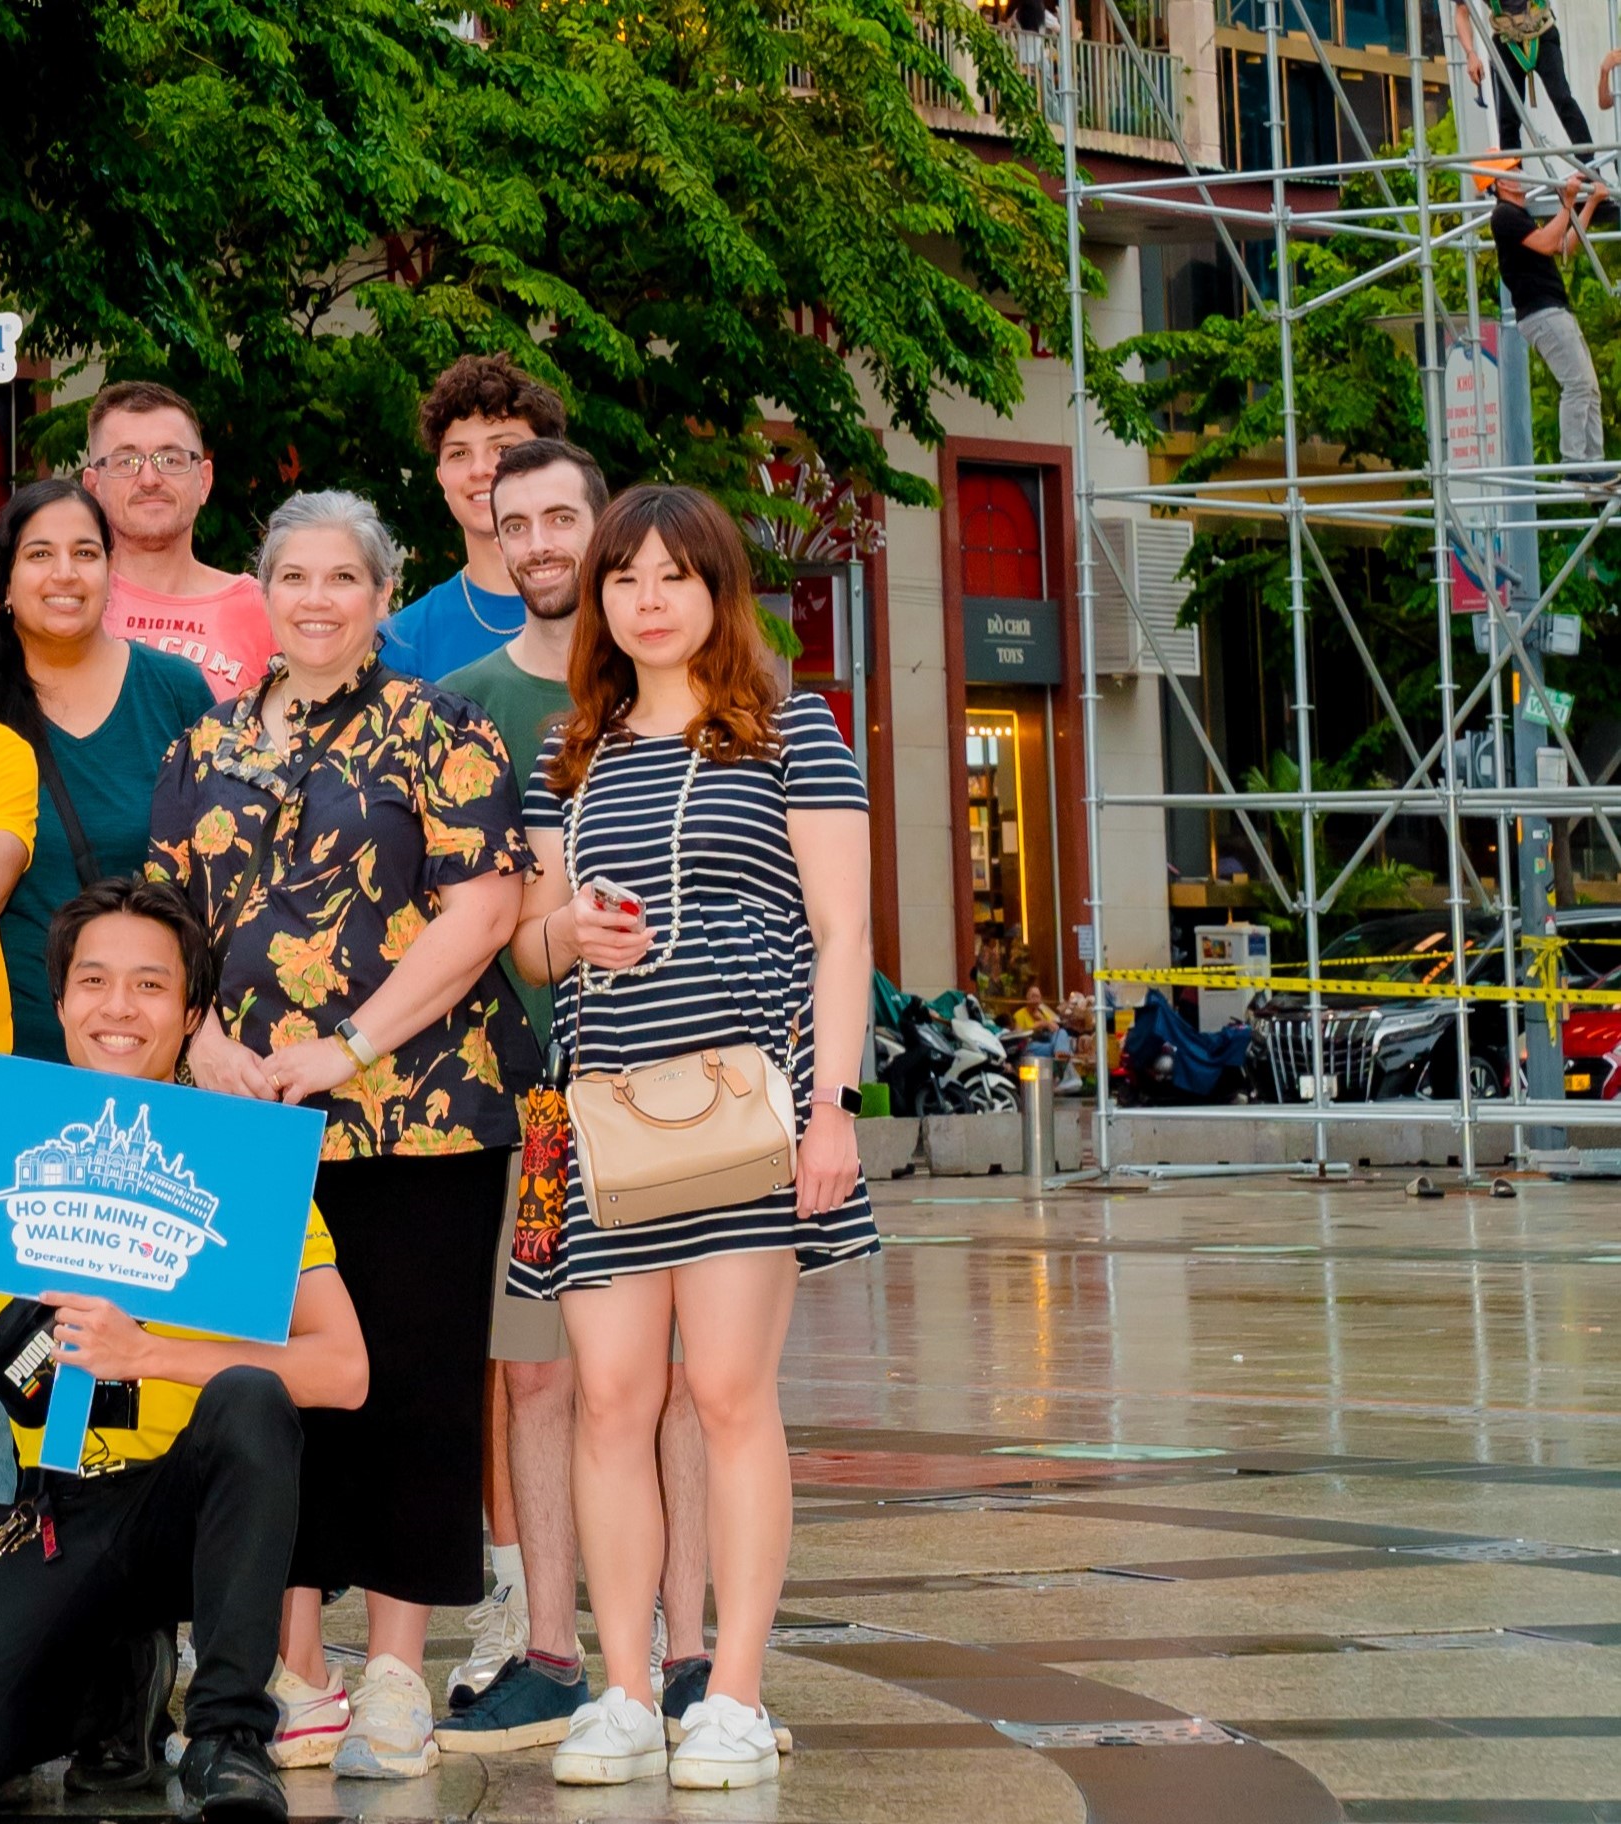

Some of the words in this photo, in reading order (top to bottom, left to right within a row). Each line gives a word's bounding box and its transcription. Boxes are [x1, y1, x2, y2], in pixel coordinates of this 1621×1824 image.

[126, 616, 206, 635] ORIGINAL
[986, 612, 1003, 635] ĐỒ
[1005, 617, 1032, 637] CHƠI
[996, 647, 1024, 664] TOYS
[16, 1200, 46, 1217] HO
[53, 1199, 88, 1218] CHI
[94, 1204, 148, 1230] MINH
[152, 1220, 198, 1249] CITY
[25, 1223, 121, 1249] WALKING
[24, 1247, 84, 1268] Operated
[88, 1258, 105, 1273] by
[108, 1262, 170, 1284] Vietravel
[3, 1329, 57, 1388] PUMA
